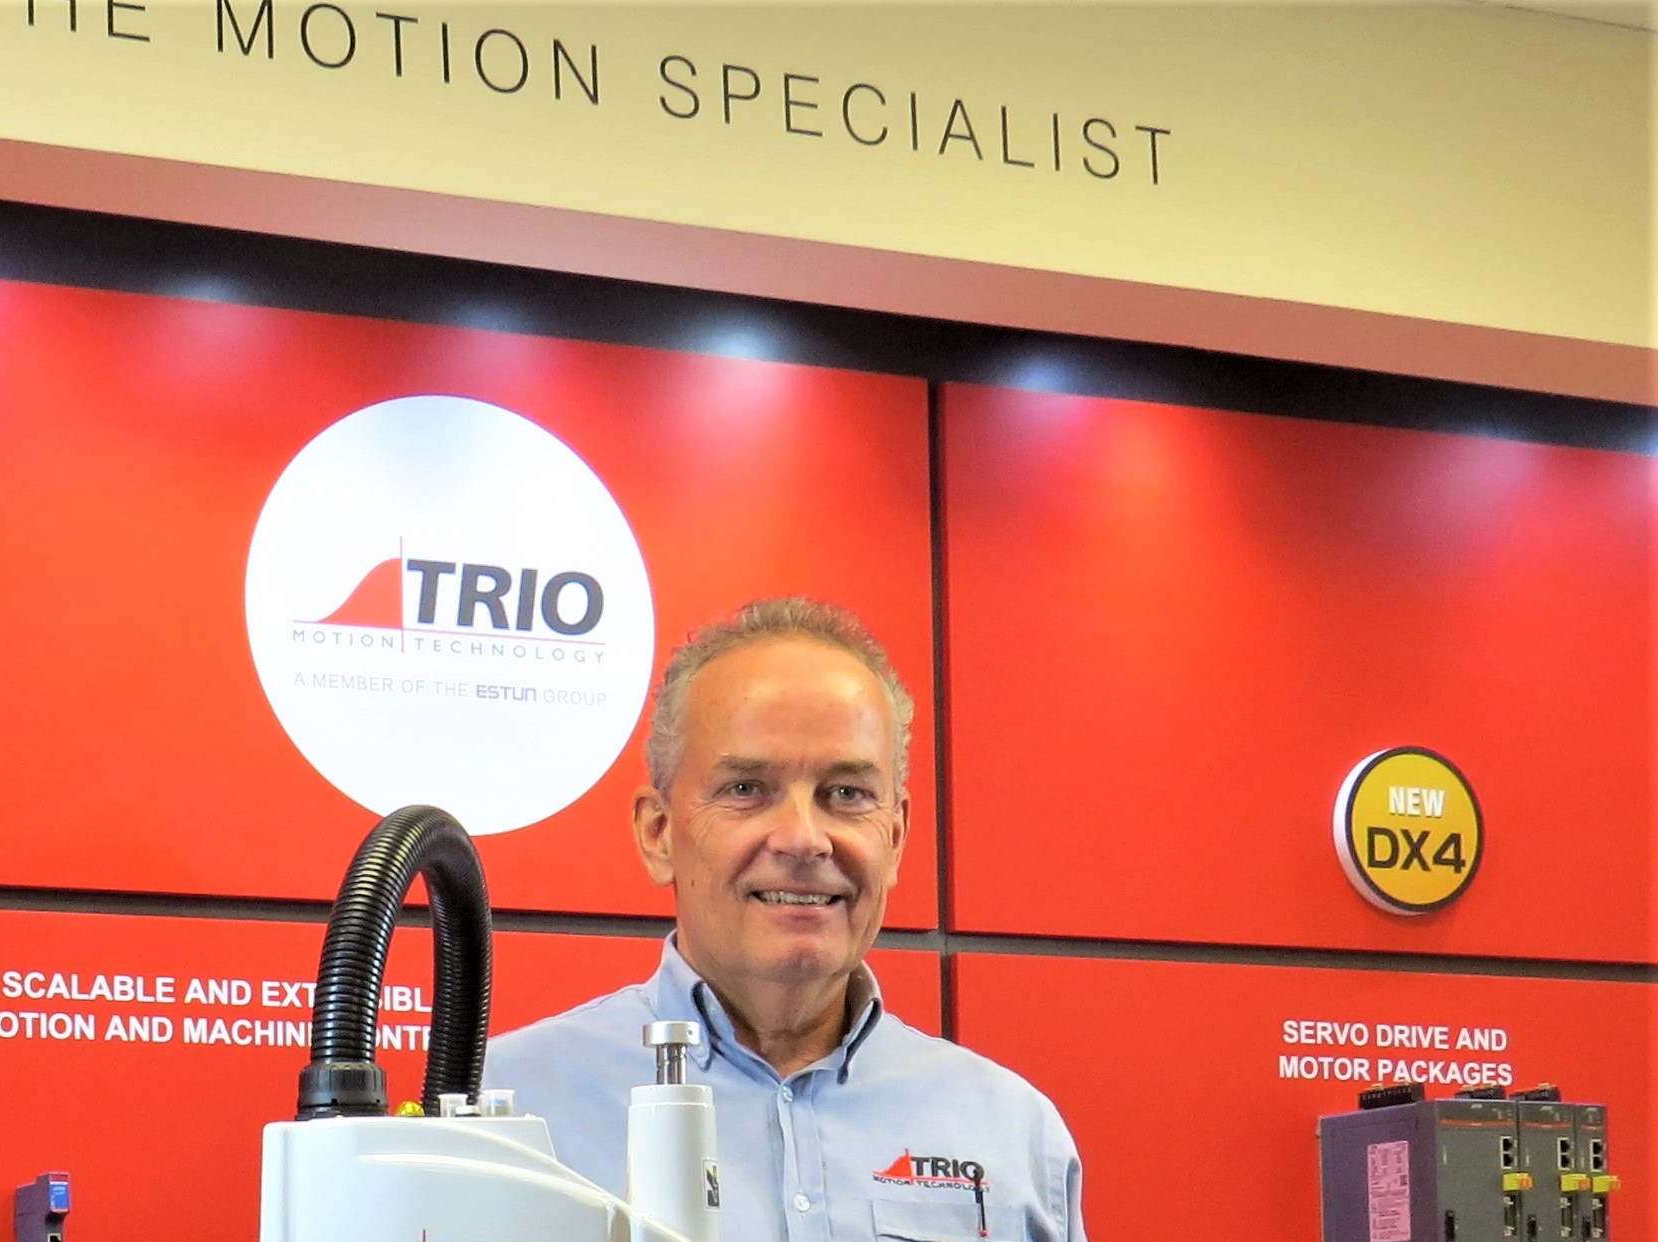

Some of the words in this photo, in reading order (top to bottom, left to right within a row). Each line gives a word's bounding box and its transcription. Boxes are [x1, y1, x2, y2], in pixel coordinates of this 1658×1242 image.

[216, 0, 601, 107] MOTION
[659, 55, 1172, 186] SPECIALIST
[406, 558, 604, 636] TRIO
[293, 629, 394, 649] MOTION
[414, 637, 605, 663] TECHNOLOGY
[294, 672, 306, 687] A
[312, 673, 394, 693] MEMBER
[401, 679, 425, 694] OF
[432, 680, 468, 697] THE
[476, 684, 537, 702] ESTUN
[543, 688, 607, 706] GROUP
[1388, 786, 1446, 818] NEW
[1367, 826, 1466, 874] DX4
[3, 971, 175, 1002] SCALABLE
[185, 979, 251, 1005] AND
[105, 1015, 173, 1042] AND
[184, 1018, 312, 1046] MACHIN
[1284, 1021, 1369, 1045] SERVO
[1377, 1025, 1449, 1049] DRIVE
[1456, 1028, 1506, 1051] AND
[1280, 1056, 1370, 1080] MOTOR
[1378, 1060, 1512, 1086] PACKAGES
[911, 1157, 984, 1181] TRIO
